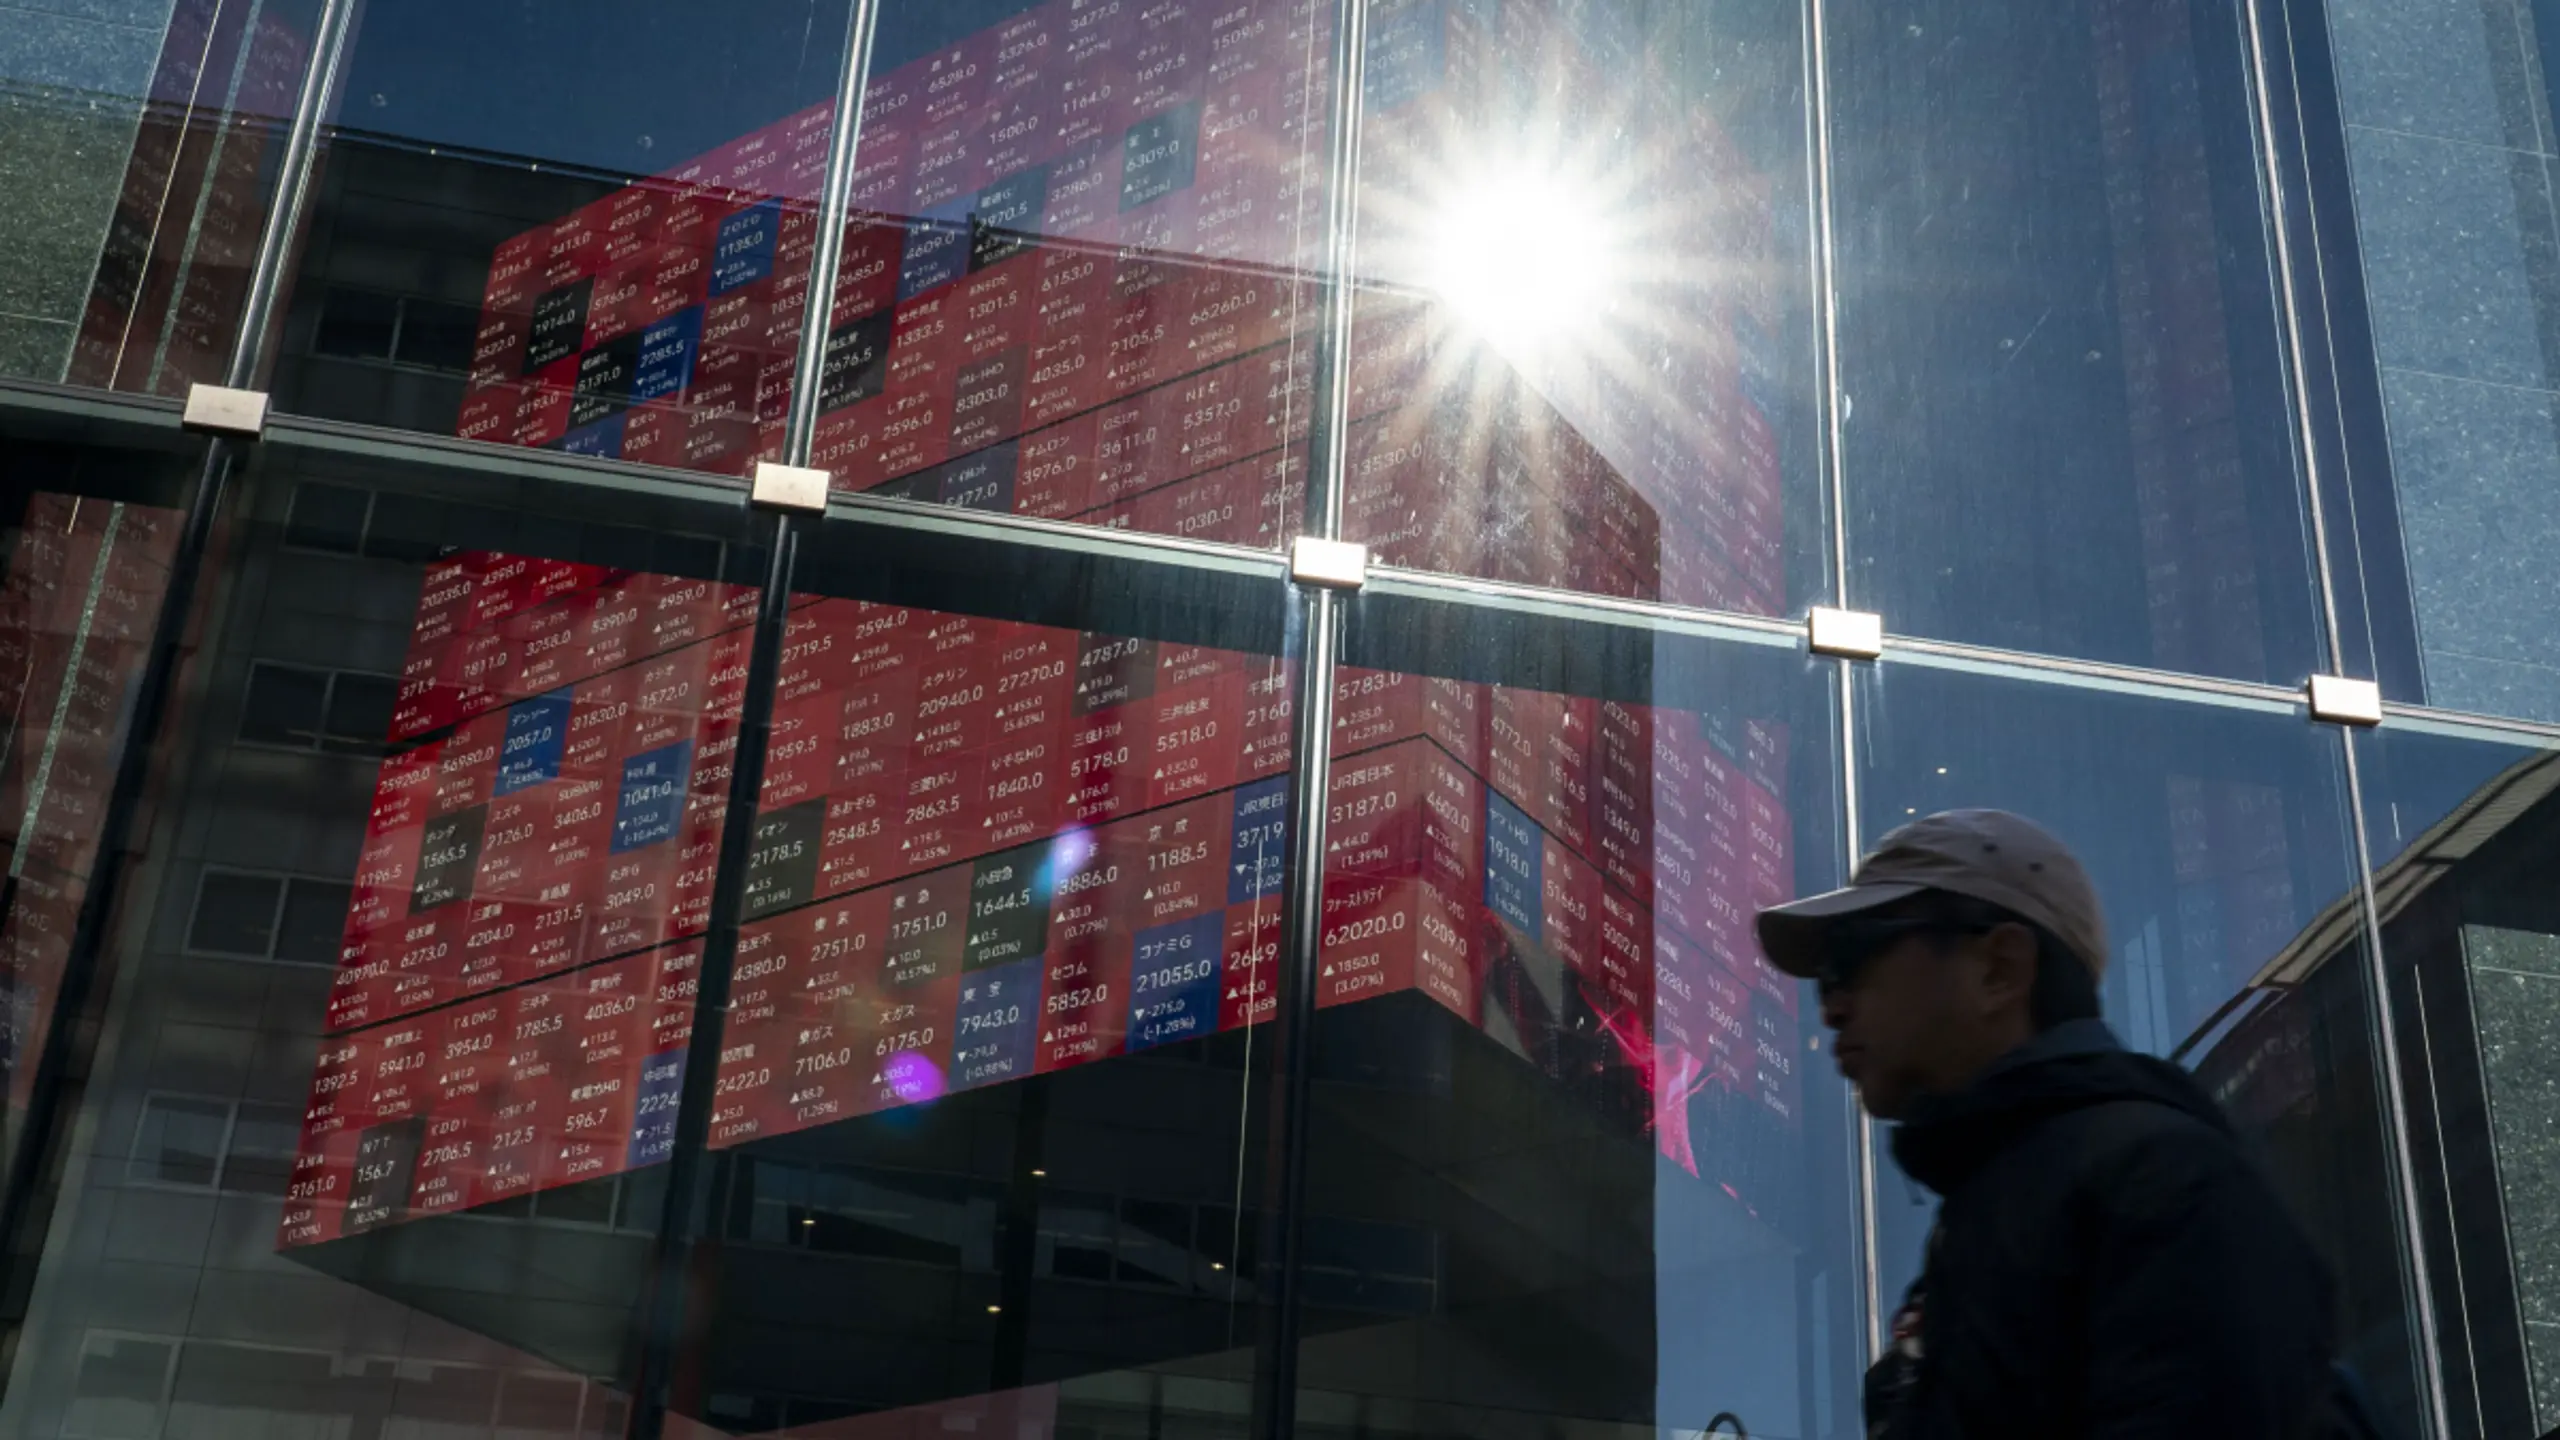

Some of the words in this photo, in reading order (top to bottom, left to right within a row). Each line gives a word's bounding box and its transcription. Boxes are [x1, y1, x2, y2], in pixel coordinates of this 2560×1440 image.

[1069, 3, 1119, 32] 3477.0
[1063, 86, 1111, 114] 1164.0
[990, 117, 1038, 144] 1500.0
[1125, 140, 1180, 172] 6309.0
[720, 232, 764, 258] 1135.0
[906, 231, 956, 260] 4609.0
[1041, 262, 1094, 293] 6153.0
[968, 290, 1019, 321] 1301.5
[1188, 291, 1256, 325] 66260.0
[896, 321, 944, 349] 1333.5
[1109, 324, 1164, 356] 2105.5
[1031, 354, 1086, 385] 4035.0
[955, 383, 1009, 414] 8303.0
[882, 411, 934, 441] 2596.0
[1182, 398, 1241, 430] 5357.0
[1100, 426, 1157, 458] 3611.0
[1022, 455, 1077, 486] 3976.0
[1175, 505, 1233, 536] 1030.0
[785, 617, 818, 638] ローム
[855, 609, 909, 640] 2594.0
[525, 629, 572, 657] 3258.0
[780, 635, 833, 665] 2719.5
[1002, 641, 1048, 664] HOYA
[1080, 637, 1139, 669] 4787.0
[921, 666, 968, 691] スクリン
[998, 659, 1065, 693] 27270.0
[1338, 671, 1403, 700] 5783.0
[918, 685, 983, 718] 20940.0
[1007, 696, 1043, 713] 1455.0
[571, 702, 629, 732] 31830.0
[770, 718, 804, 736] ニコン
[843, 712, 896, 741] 1883.0
[504, 726, 552, 754] 2057.0
[769, 734, 818, 765] 1959.5
[1156, 721, 1217, 753] 5518.0
[1070, 747, 1129, 778] 5178.0
[987, 771, 1043, 801] 1840.0
[1331, 763, 1395, 791] JR西日本
[1548, 759, 1587, 803] 1516.5
[624, 780, 672, 807] 1041.0
[1080, 783, 1109, 800] 176.0
[554, 802, 602, 829] 3406.0
[905, 795, 960, 825] 2863.5
[1331, 791, 1397, 824] 3187.0
[486, 823, 534, 851] 2126.0
[827, 817, 881, 847] 2548.5
[1603, 804, 1640, 845] 1349.0
[424, 844, 467, 869] 1565.5
[750, 840, 803, 869] 2178.5
[1148, 841, 1208, 872] 1188.5
[1341, 845, 1389, 869] (1.39%)
[1488, 835, 1530, 879] 1918.0
[755, 877, 772, 890] 3.5
[1057, 865, 1119, 896] 3886.0
[1157, 880, 1182, 896] 10.0
[604, 883, 655, 910] 3049.0
[974, 888, 1031, 918] 1644.5
[1153, 893, 1199, 917] (0.84%)
[1546, 880, 1587, 921] 5166.0
[535, 903, 584, 930] 2131.5
[891, 911, 948, 939] 1751.0
[1064, 916, 1109, 941] (0.77%)
[1324, 911, 1405, 946] 62020.0
[466, 924, 515, 948] 4204.0
[810, 933, 866, 963] 2751.0
[981, 928, 999, 942] 0.5
[1139, 934, 1194, 960] コナミG
[1422, 913, 1468, 957] 4209.0
[1602, 921, 1640, 962] 5002.0
[400, 942, 448, 969] 6273.0
[978, 940, 1022, 962] (0.03%)
[1337, 953, 1380, 973] 1850.0
[733, 955, 787, 982] 4380.0
[1050, 961, 1088, 981] セコム
[1136, 959, 1212, 993] 21055.0
[1335, 970, 1384, 995] (3.07%)
[584, 995, 636, 1021] 4036.0
[1047, 983, 1108, 1015] 5852.0
[1145, 999, 1186, 1019] -275.0
[516, 1014, 563, 1040] 1785.5
[960, 1004, 1020, 1035] 7943.0
[1057, 1021, 1088, 1039] 129.0
[445, 1033, 493, 1060] 3954.0
[876, 1026, 934, 1057] 6175.0
[377, 1052, 426, 1078] 5941.0
[795, 1047, 850, 1075] 7106.0
[315, 1068, 359, 1094] 1392.5
[716, 1068, 769, 1096] 2422.0
[430, 1118, 468, 1136] KDDI
[565, 1108, 608, 1132] 596.7
[720, 1105, 744, 1121] 25.0
[361, 1135, 391, 1153] NTT
[493, 1125, 535, 1150] 212.5
[422, 1141, 472, 1167] 2706.5
[357, 1160, 396, 1183] 156.7
[288, 1174, 336, 1200] 3161.0
